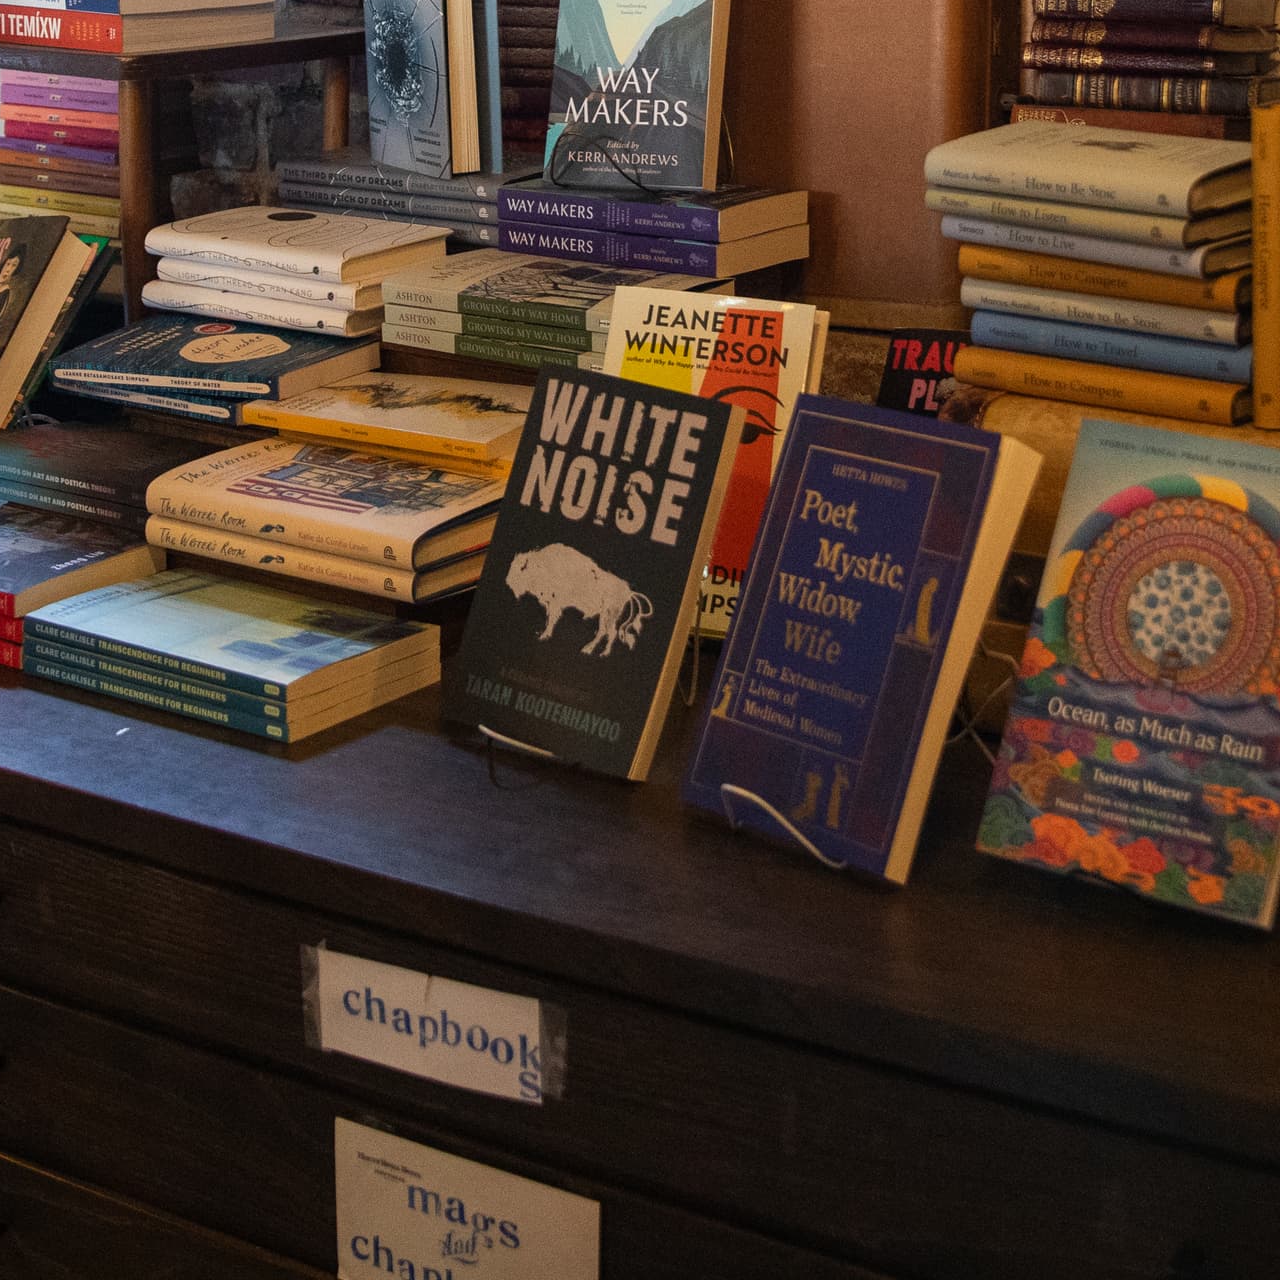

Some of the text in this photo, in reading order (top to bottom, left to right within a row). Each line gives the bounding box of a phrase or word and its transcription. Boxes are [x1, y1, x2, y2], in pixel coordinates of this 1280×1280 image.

[7, 11, 61, 40] TEMÍXW
[596, 66, 659, 94] WAY
[566, 96, 689, 128] MAKERS
[568, 150, 679, 167] KERRI ANDREWS
[284, 168, 299, 178] THE
[301, 169, 327, 181] THIRD
[355, 175, 367, 184] OF
[368, 176, 404, 188] DREAMS
[1025, 176, 1117, 200] How to Be Stoic
[506, 197, 594, 220] WAY MAKERS
[395, 291, 580, 325] ASHTON GROWING MY WAY HOME
[642, 304, 777, 340] JEANETTE
[624, 329, 789, 369] WINTERSON
[1054, 334, 1138, 359] How to Travel
[170, 379, 190, 387] THEORY
[200, 381, 221, 389] WATER
[1023, 372, 1124, 400] How to Compete
[540, 377, 709, 479] WHITE
[520, 446, 691, 547] NOISE
[799, 488, 860, 535] Poet,
[813, 536, 906, 593] Mystic,
[776, 571, 863, 625] Widow,
[783, 619, 842, 665] Wife
[36, 664, 229, 723] CLARE CARLISLE TRANSCENDENCE FOR BEGINNERS
[748, 678, 800, 708] Lives of
[755, 658, 867, 709] The Extraordinary
[465, 673, 621, 743] TARAN KOOTENHAYOO
[742, 698, 844, 746] Medieval Women
[1047, 695, 1264, 762] Ocean, as Much as Rain
[1093, 767, 1193, 803] Tsering Woeser
[406, 1183, 521, 1250] mags
